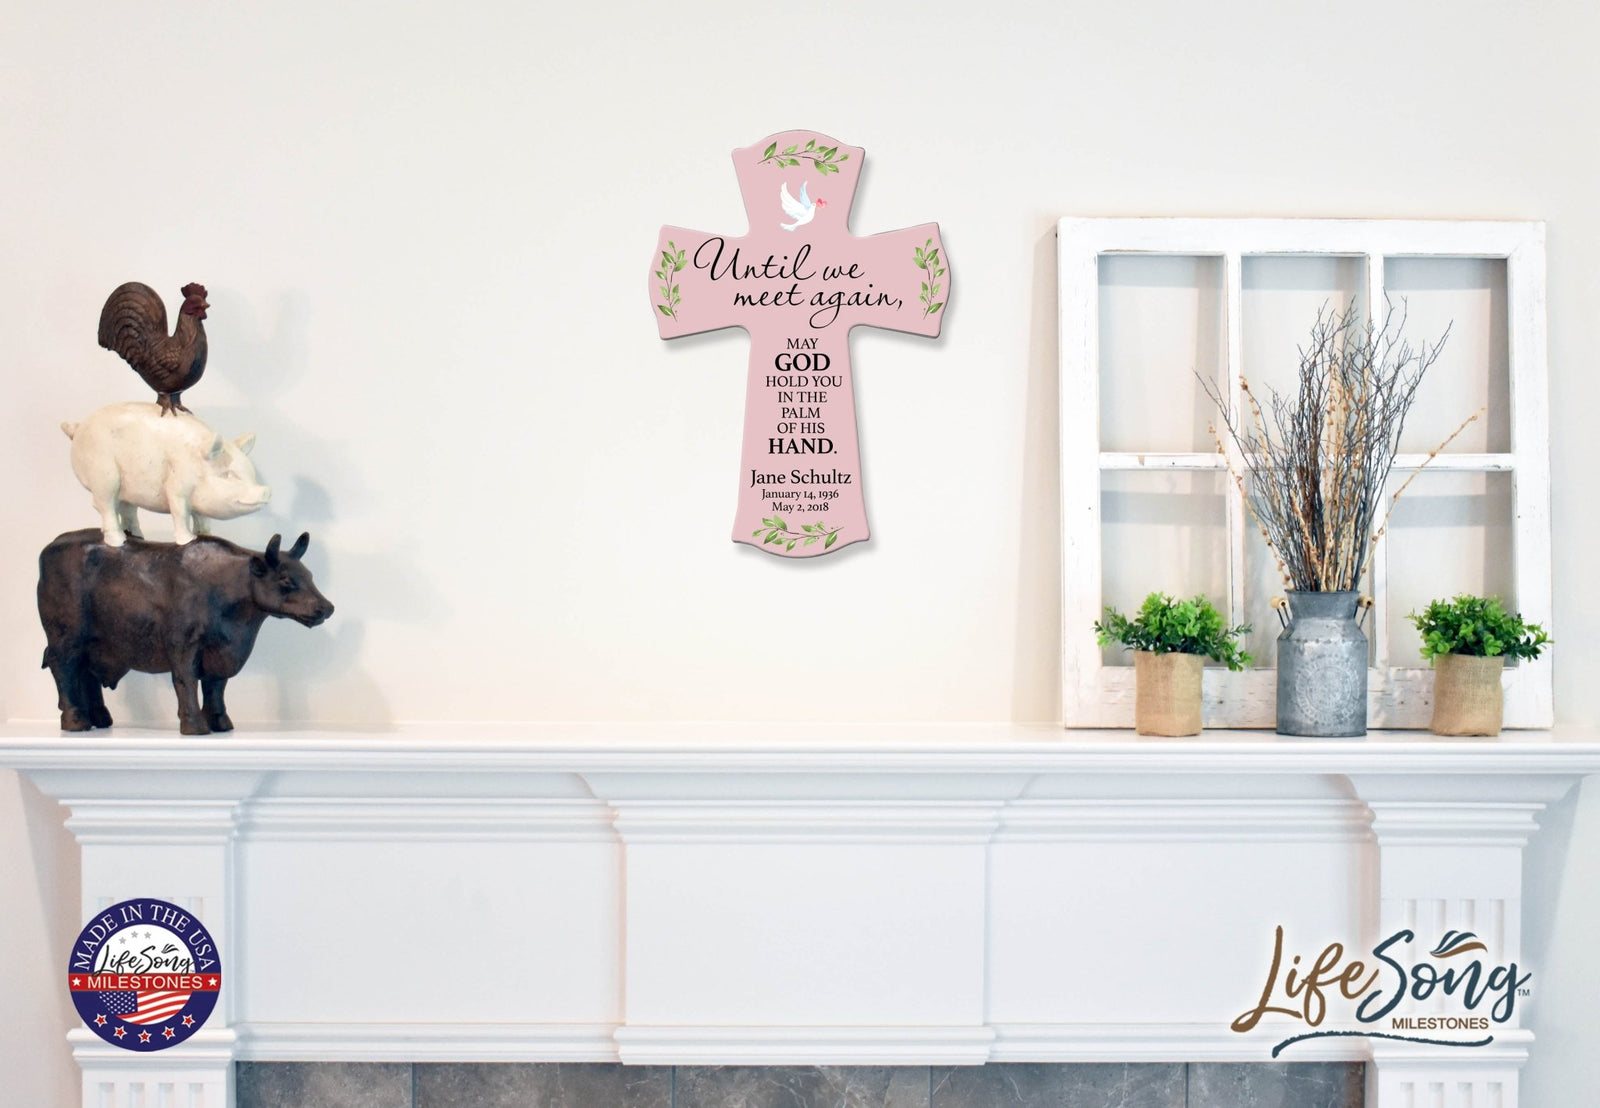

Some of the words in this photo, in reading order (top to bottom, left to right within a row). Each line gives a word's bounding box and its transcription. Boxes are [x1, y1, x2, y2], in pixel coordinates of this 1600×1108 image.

[693, 236, 817, 281] Until
[822, 263, 865, 281] we
[733, 283, 805, 307] meet
[808, 283, 903, 330] again,
[786, 337, 819, 350] MAY
[774, 352, 831, 372] GOD
[766, 375, 809, 388] HOLD
[811, 375, 843, 388] YOU
[778, 391, 794, 403] IN
[796, 391, 828, 403] THE
[781, 407, 821, 419] PALM
[776, 422, 798, 434] OF
[800, 422, 825, 434] HIS
[768, 437, 838, 455] HAND.
[750, 469, 786, 489] Jane
[790, 468, 852, 485] Schultz
[761, 488, 802, 501] January
[803, 490, 817, 501] 14,
[818, 489, 840, 500] 1936
[772, 501, 795, 514] May
[797, 503, 805, 513] 2,
[807, 501, 830, 512] 2018
